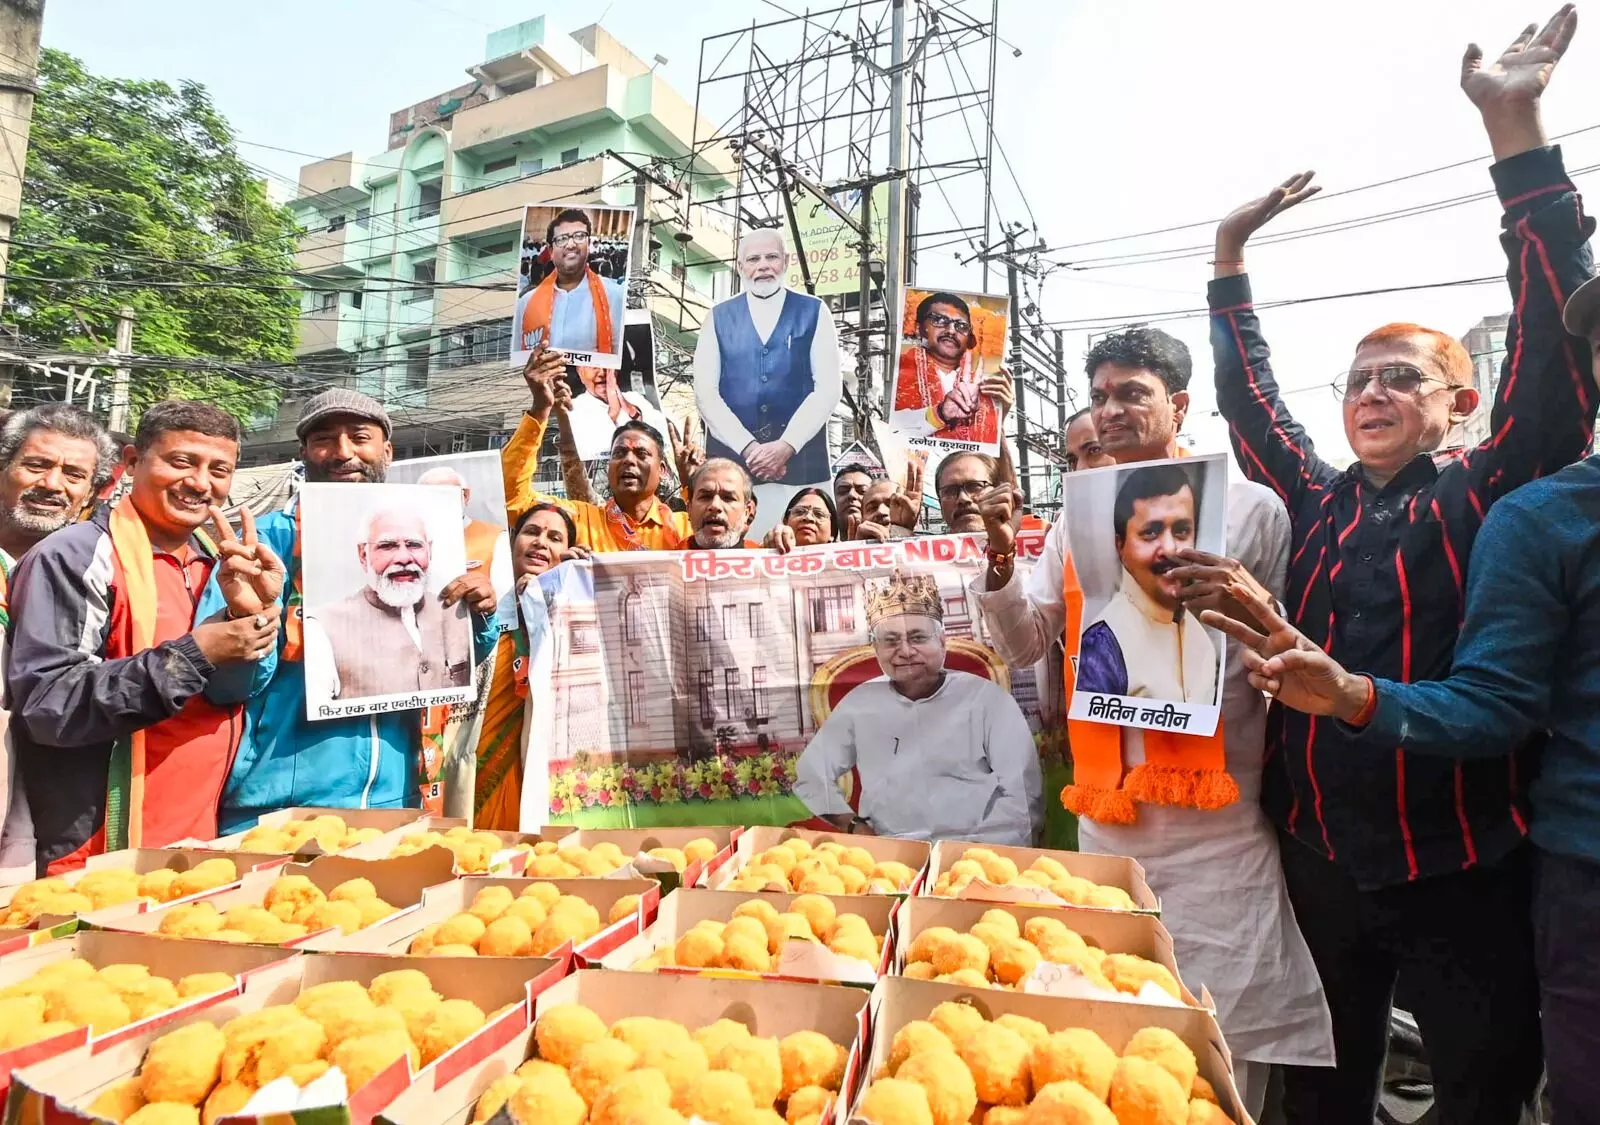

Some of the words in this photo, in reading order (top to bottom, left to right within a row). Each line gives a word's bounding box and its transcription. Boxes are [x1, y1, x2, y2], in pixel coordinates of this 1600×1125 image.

[564, 351, 592, 364] गुप्ता
[908, 437, 937, 447] रत्नेश
[939, 441, 980, 452] कुशवाहा
[683, 550, 755, 579] फिर
[761, 552, 826, 576] एक
[833, 546, 896, 568] बार
[903, 536, 982, 562] NDA
[318, 704, 342, 717] फिर
[345, 705, 366, 714] एक
[391, 695, 427, 710] एनडीए
[430, 693, 465, 706] सरकार
[1088, 695, 1138, 722] नितिन
[1140, 703, 1191, 730] नवीन
